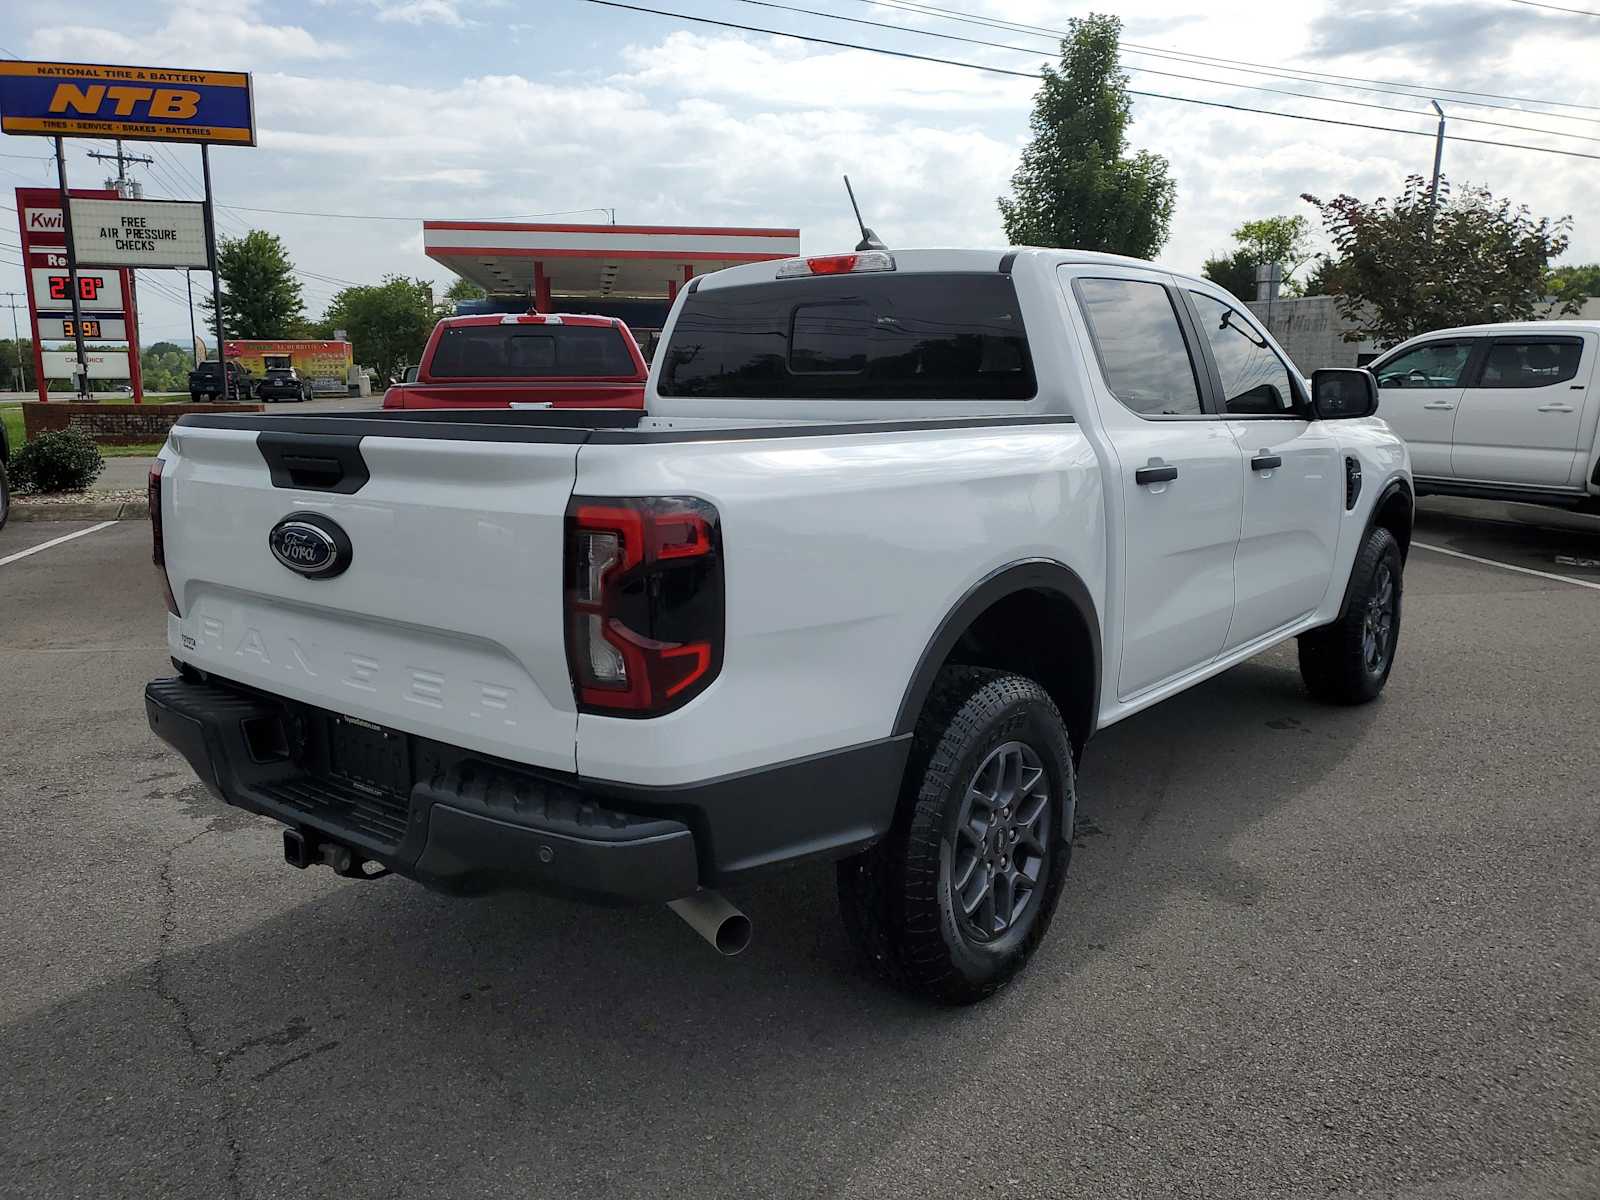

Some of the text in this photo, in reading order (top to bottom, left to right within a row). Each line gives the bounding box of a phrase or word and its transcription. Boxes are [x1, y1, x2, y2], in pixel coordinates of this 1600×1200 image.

[37, 66, 206, 83] NATIONAL TIRE & BATTERY
[48, 83, 201, 119] NTB
[42, 120, 212, 136] TIRES SERVICE BRAKES BATTERIES
[31, 212, 64, 228] Kwi
[121, 216, 146, 228] FREE
[100, 228, 177, 240] AIR PRESSURE
[115, 240, 155, 251] CHECKS
[47, 254, 68, 267] Re
[281, 532, 317, 561] Ford
[199, 613, 519, 727] RANGER
